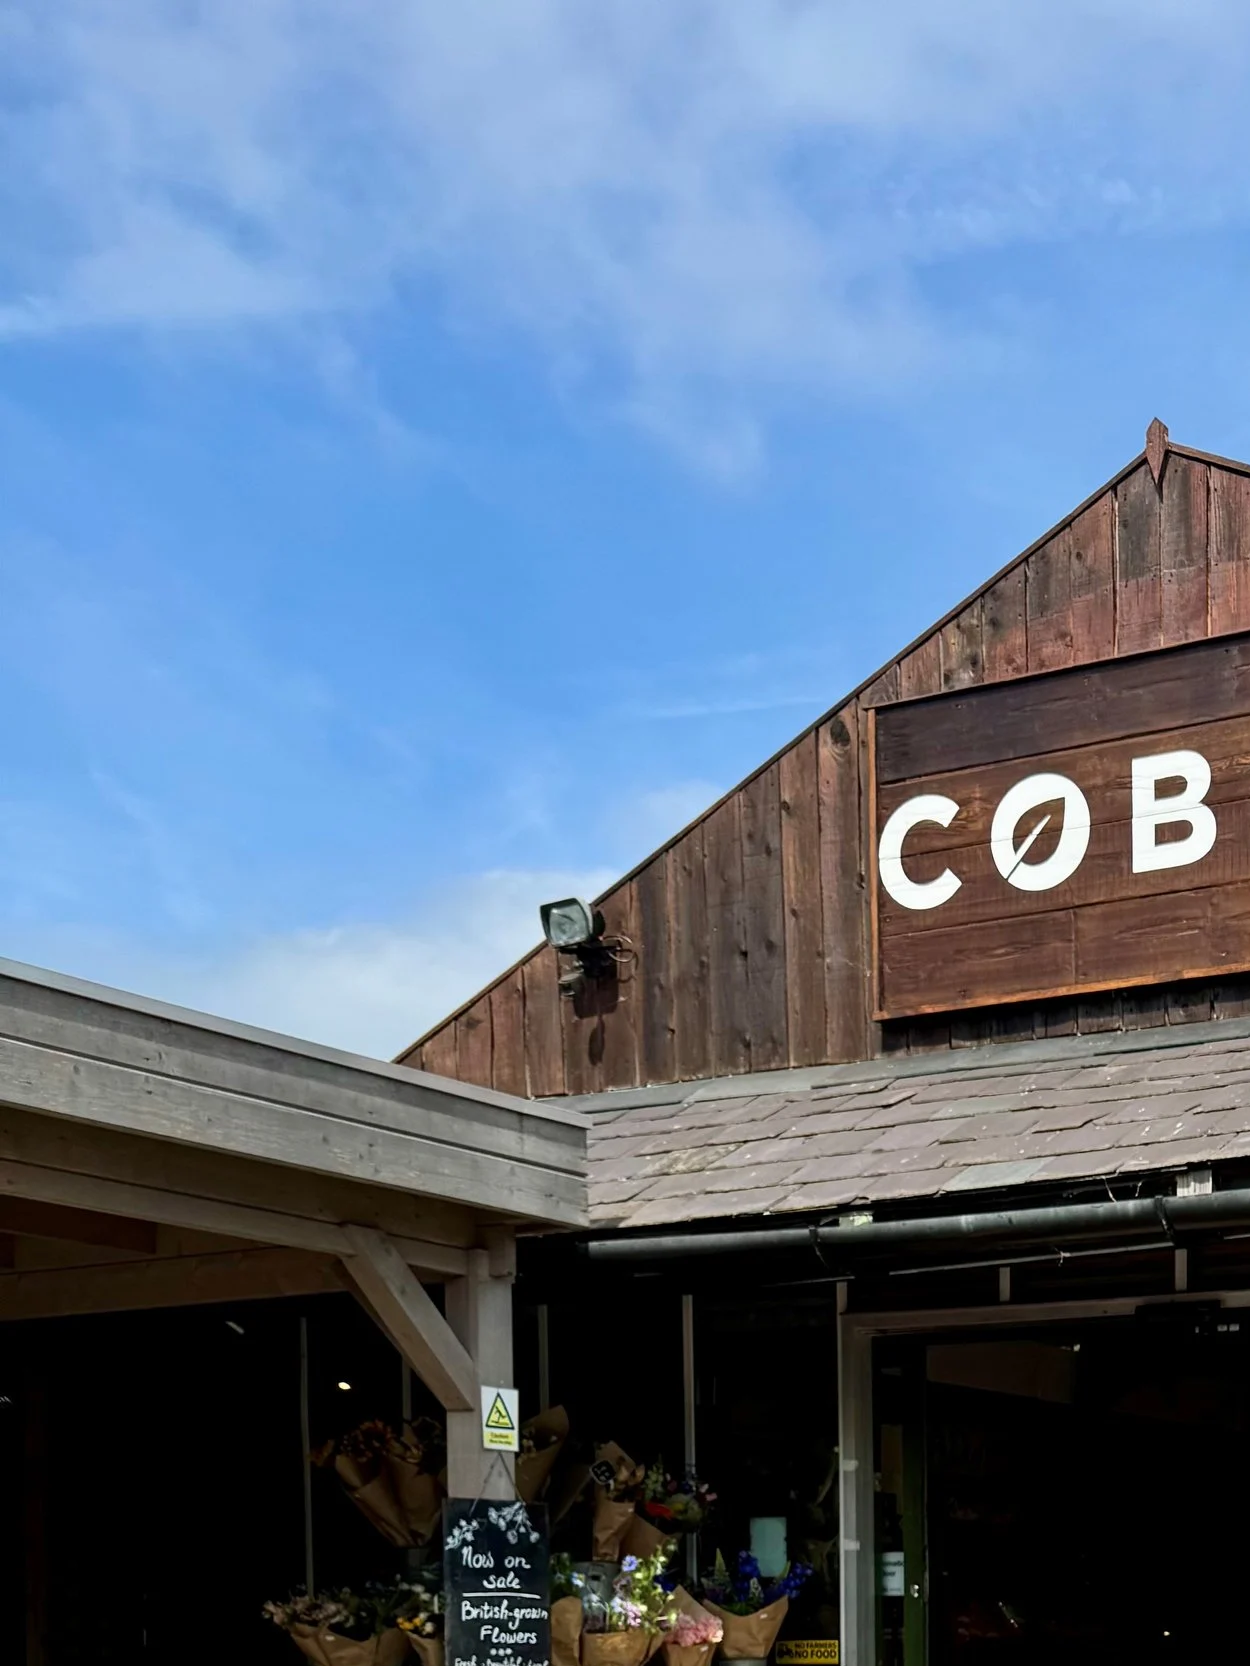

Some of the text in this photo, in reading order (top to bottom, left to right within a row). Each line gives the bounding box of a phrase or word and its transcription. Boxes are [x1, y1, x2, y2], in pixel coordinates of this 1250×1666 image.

[462, 1545, 531, 1569] Now on
[462, 1599, 548, 1630] British-grown
[480, 1625, 537, 1644] Flowers
[795, 1650, 837, 1659] NO FOOD
